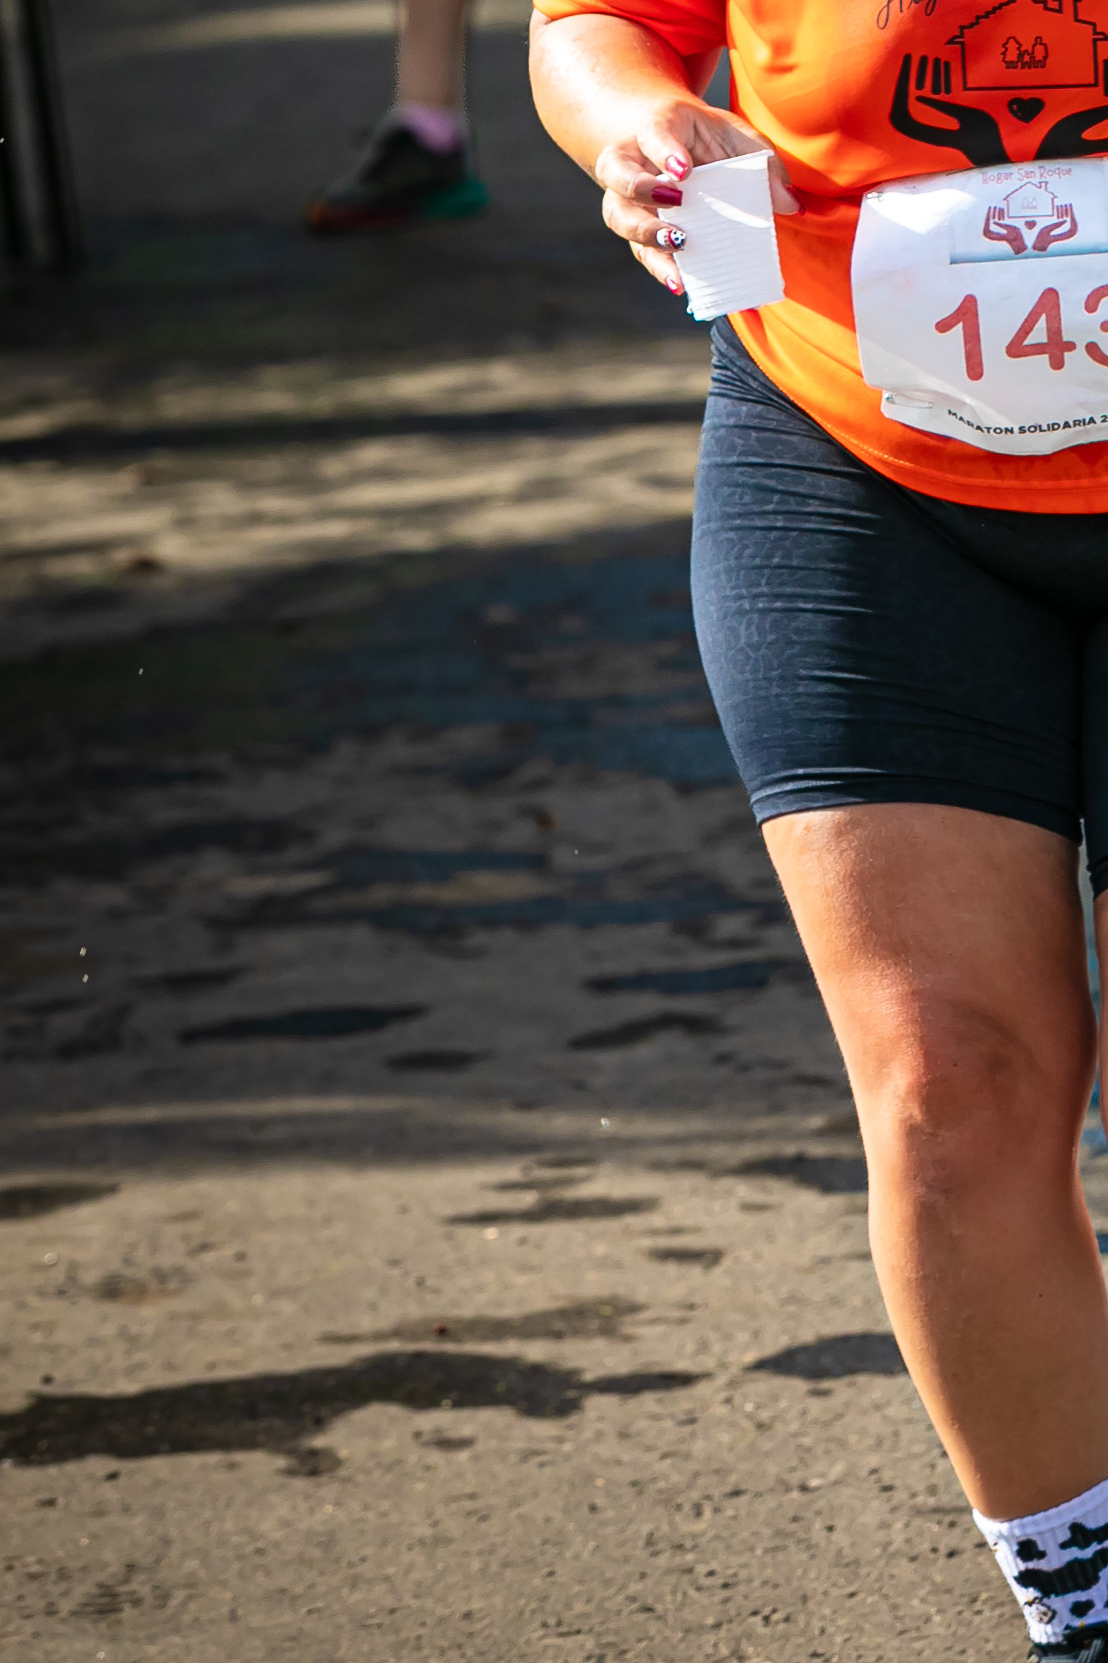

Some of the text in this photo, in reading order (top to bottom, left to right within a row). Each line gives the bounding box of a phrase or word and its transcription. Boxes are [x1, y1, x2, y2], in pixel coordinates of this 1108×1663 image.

[982, 165, 1073, 185] Hogar San Roque
[947, 408, 1014, 435] MARATON
[1018, 415, 1097, 435] SOLIDARIA
